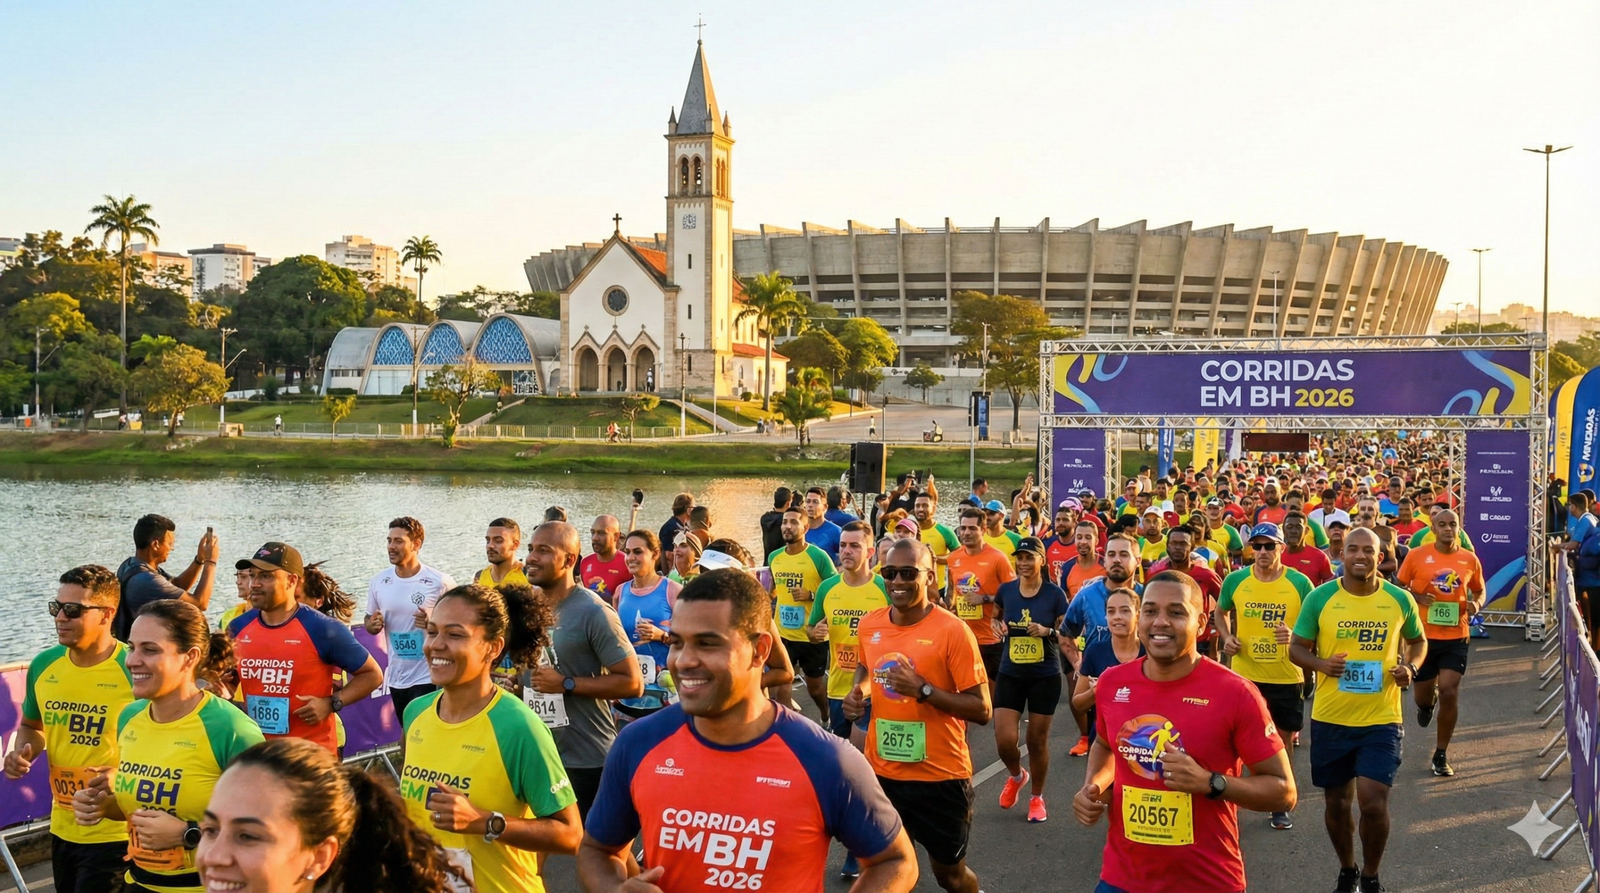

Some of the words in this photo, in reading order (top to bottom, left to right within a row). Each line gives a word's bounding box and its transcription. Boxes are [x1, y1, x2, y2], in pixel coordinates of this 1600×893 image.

[1200, 359, 1355, 382] CORRIDAS
[1200, 386, 1242, 407] EM
[1250, 386, 1291, 407] BH
[1294, 388, 1355, 408] 2026
[1244, 602, 1287, 610] CORRIDAS
[1434, 608, 1451, 618] 166
[1337, 620, 1389, 629] CORRIDAS
[1013, 644, 1037, 655] 2676
[1359, 643, 1384, 651] 2026
[240, 658, 294, 669] CORRIDAS
[1344, 670, 1375, 683] 3614
[262, 684, 290, 695] 2026
[44, 700, 108, 715] CORRIDAS
[251, 706, 280, 722] 1686
[70, 734, 101, 747] 2026
[882, 731, 915, 749] 2675
[403, 764, 472, 791] CORRIDAS
[1129, 803, 1179, 827] 20567
[661, 808, 777, 838] CORRIDAS
[703, 868, 764, 891] 2026
